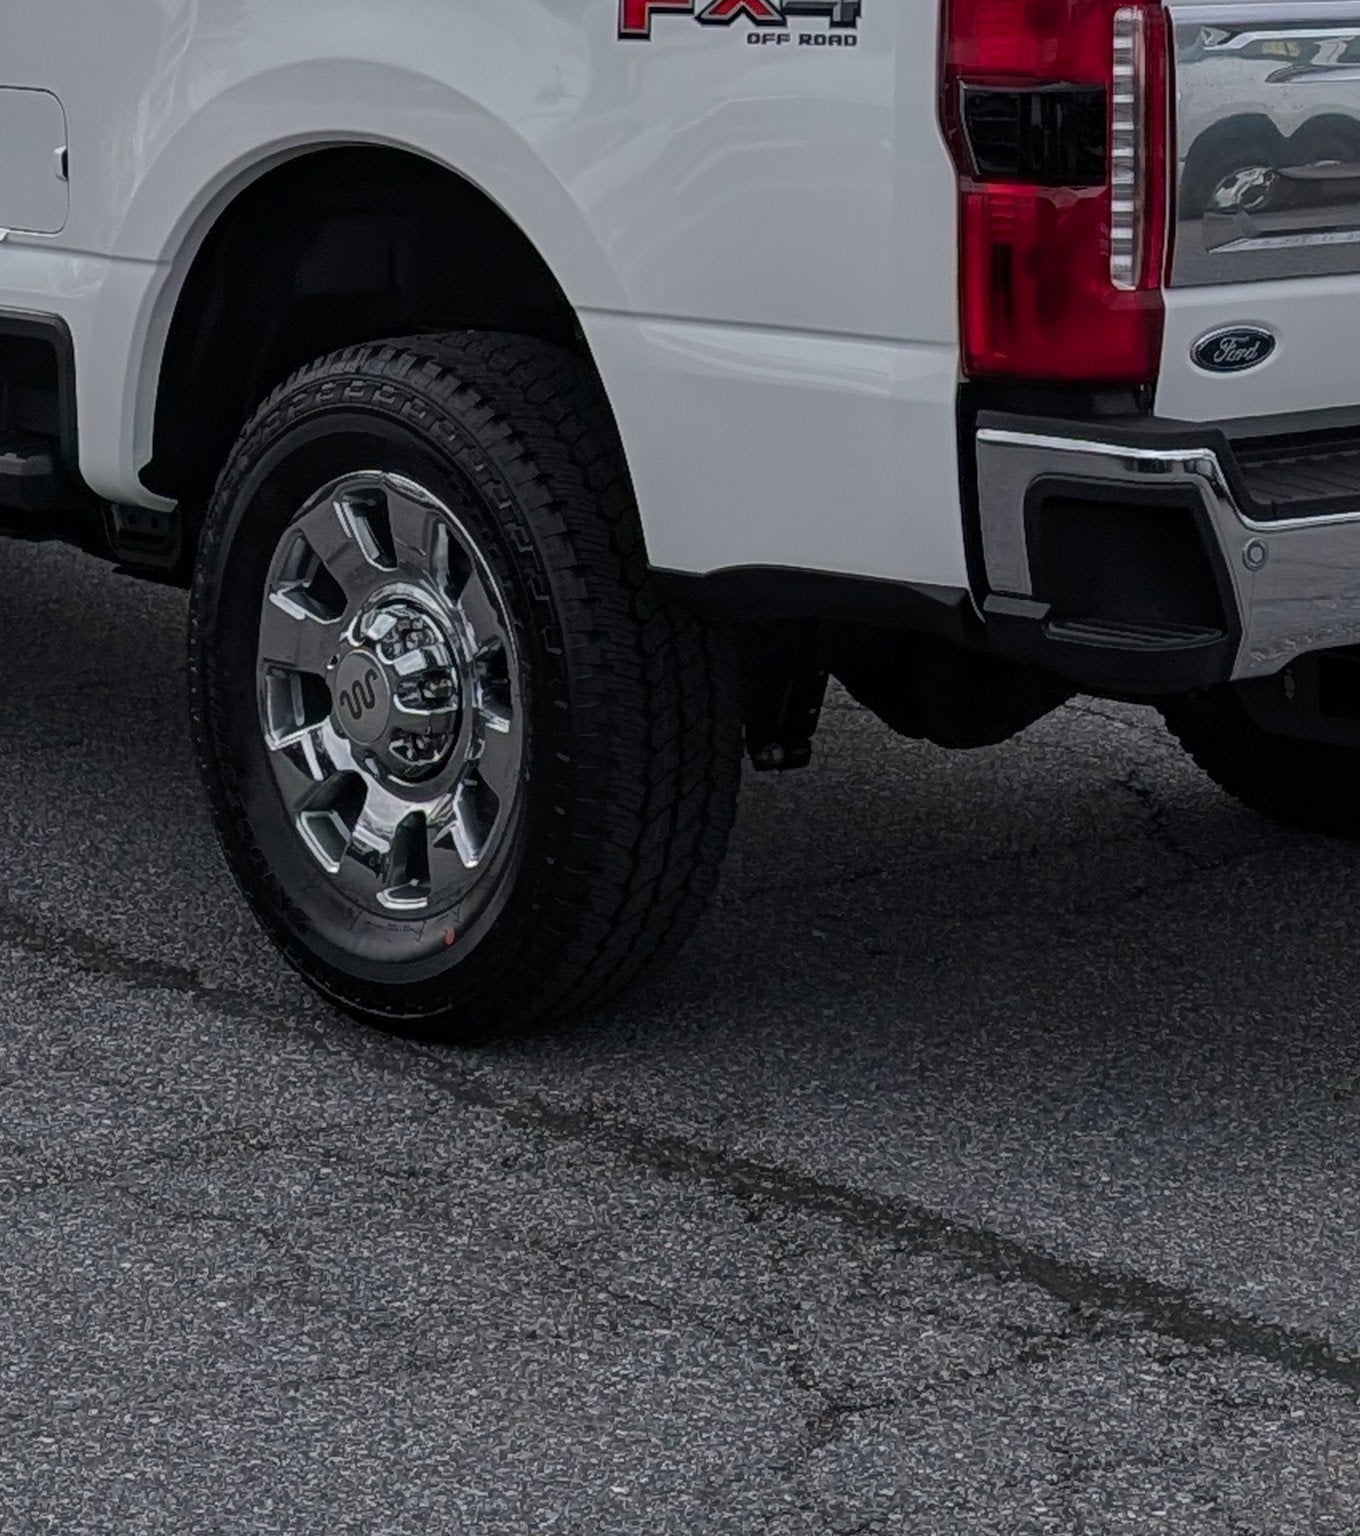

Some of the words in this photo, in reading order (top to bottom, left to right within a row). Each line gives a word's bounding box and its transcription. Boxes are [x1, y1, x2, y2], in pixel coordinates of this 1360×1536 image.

[747, 32, 791, 46] OFF
[798, 32, 858, 47] ROAD
[1213, 336, 1261, 363] Ford
